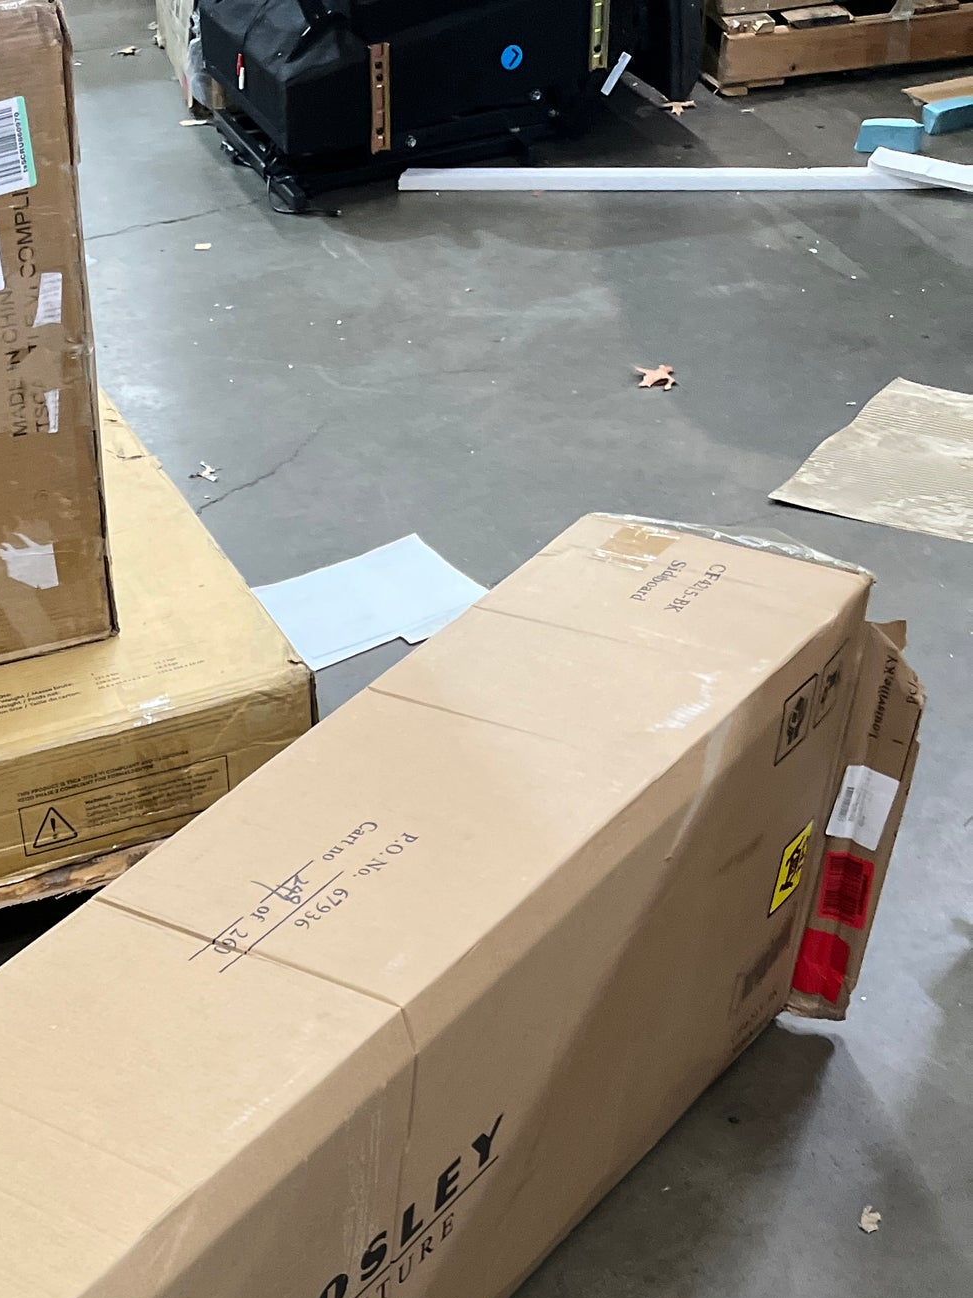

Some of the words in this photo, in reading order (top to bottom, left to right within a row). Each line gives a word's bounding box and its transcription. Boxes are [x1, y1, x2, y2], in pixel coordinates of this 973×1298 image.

[340, 821, 378, 845] Cart
[379, 832, 419, 856] P.O.
[322, 845, 345, 861] no
[352, 857, 388, 878] No.
[249, 905, 270, 923] of
[294, 887, 351, 931] 67936
